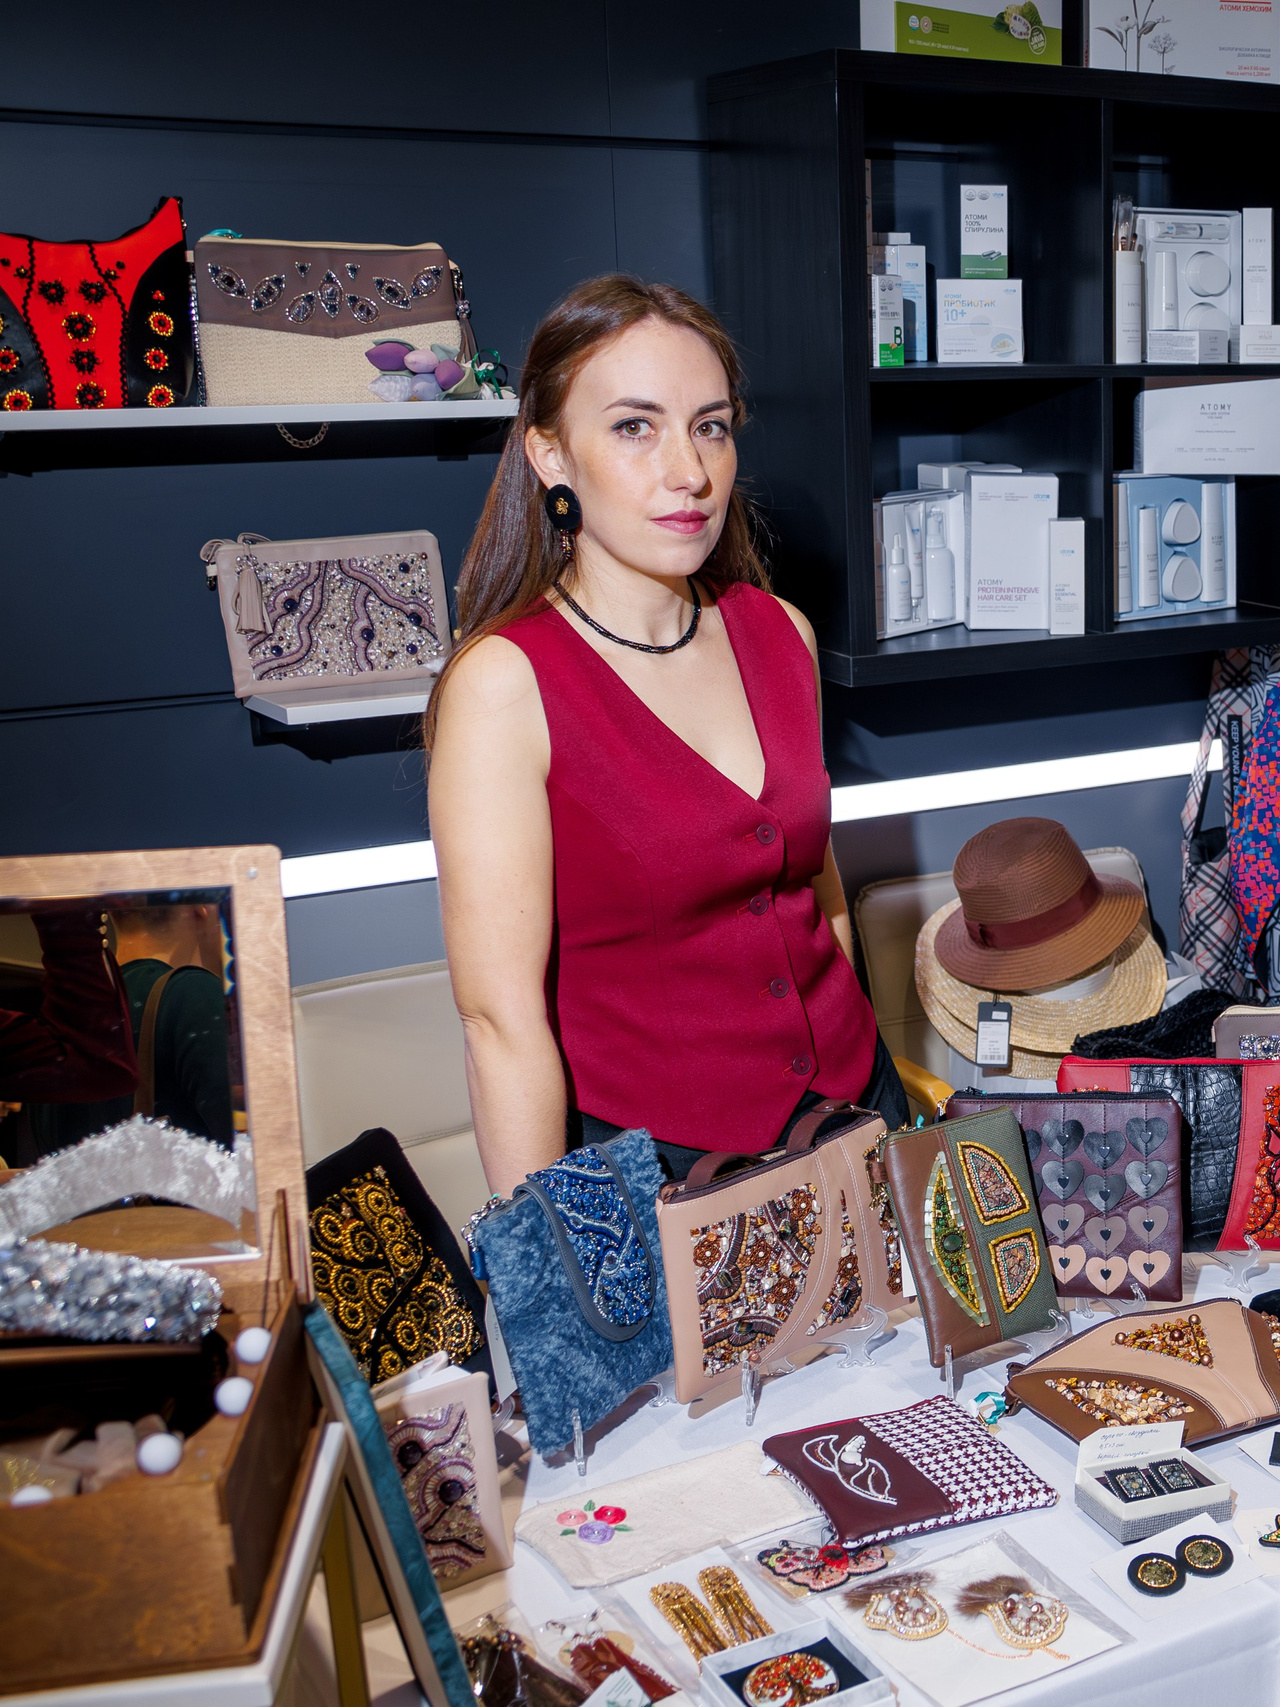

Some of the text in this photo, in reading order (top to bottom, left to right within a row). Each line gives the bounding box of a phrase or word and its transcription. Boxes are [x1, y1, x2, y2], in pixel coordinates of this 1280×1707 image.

[945, 309, 966, 321] 10+
[894, 326, 902, 347] B
[1231, 720, 1240, 743] KEEP
[1231, 744, 1240, 774] YOUNG
